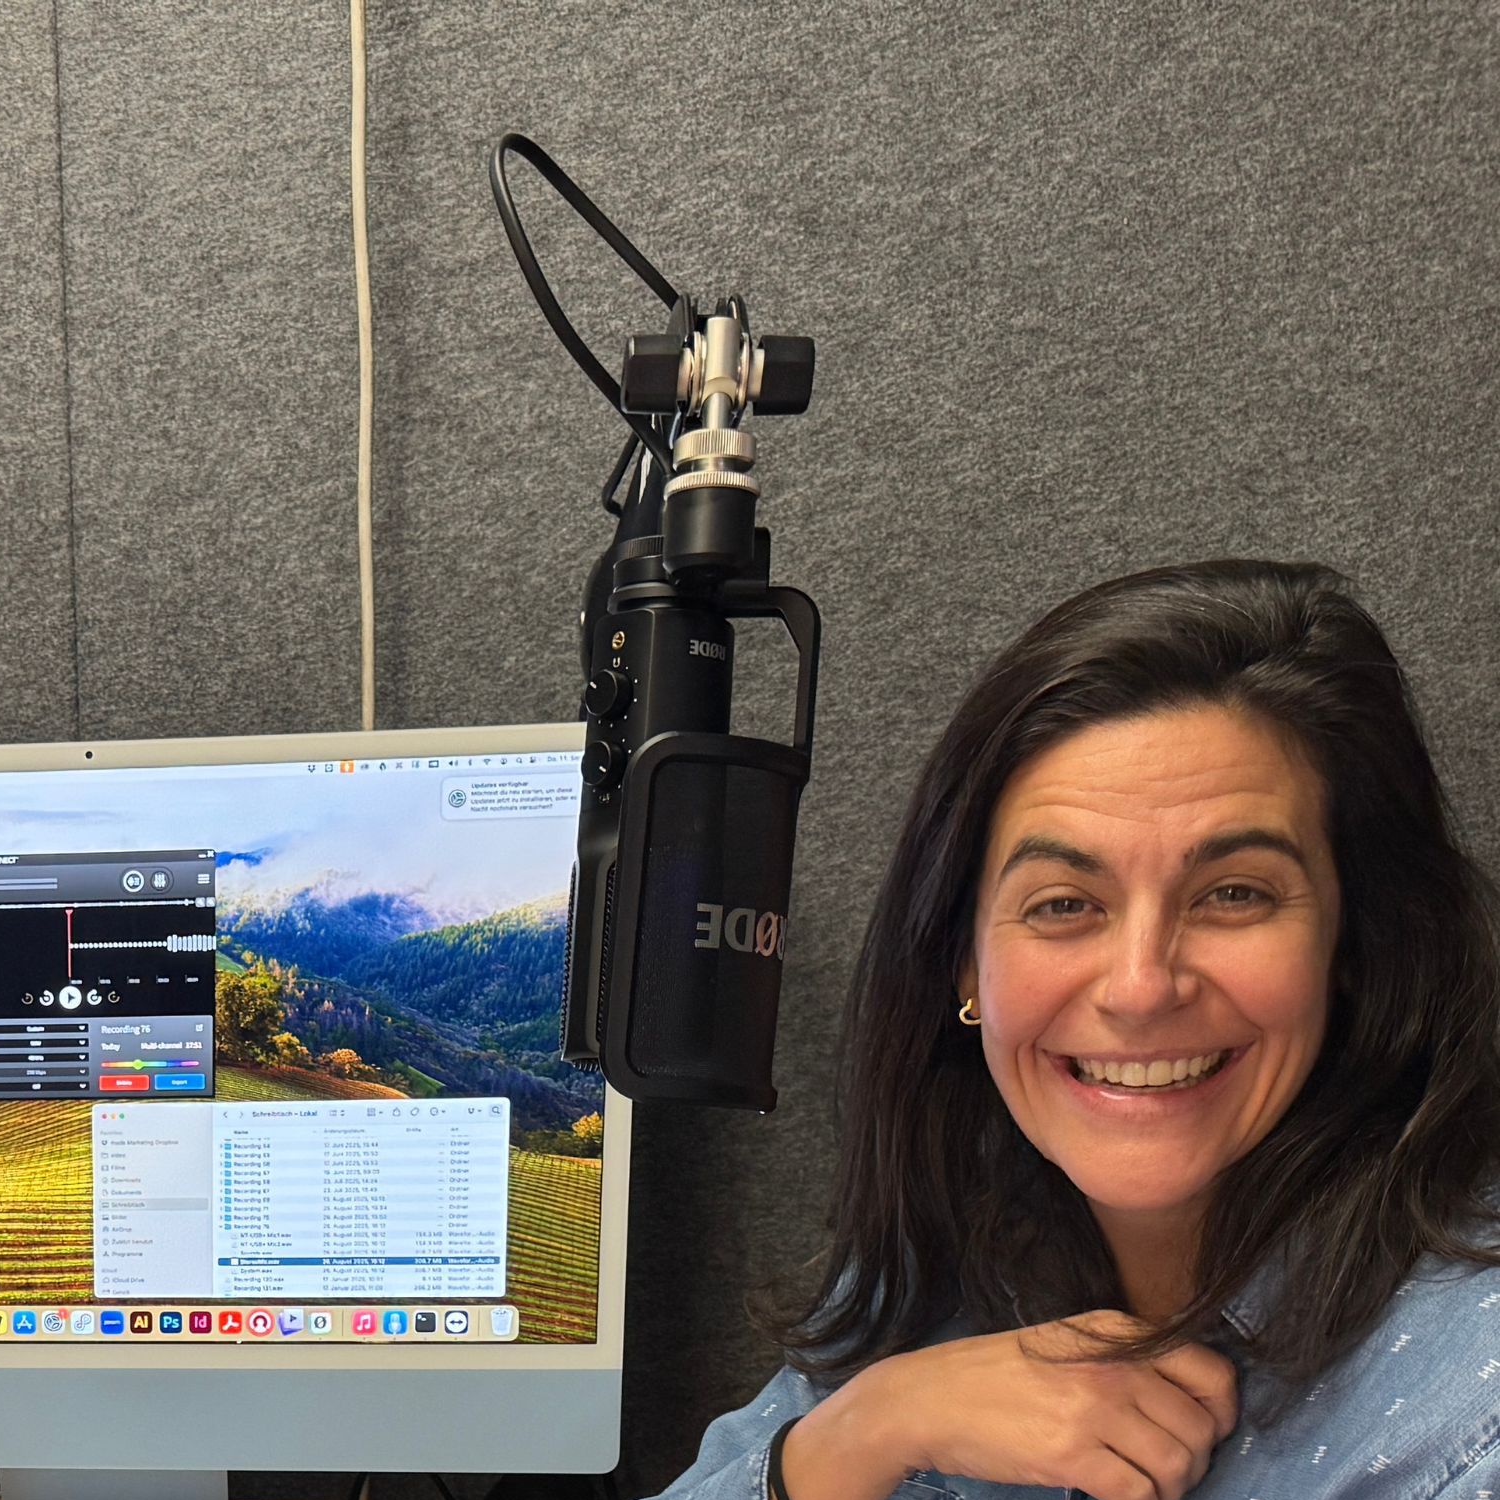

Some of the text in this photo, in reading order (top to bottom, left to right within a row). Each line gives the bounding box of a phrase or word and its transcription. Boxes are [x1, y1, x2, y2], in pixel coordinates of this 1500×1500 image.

[695, 902, 787, 960] RØDE
[101, 1024, 151, 1035] Recording 76
[134, 1315, 149, 1329] Ai
[162, 1316, 180, 1329] Ps
[194, 1315, 208, 1329] Id
